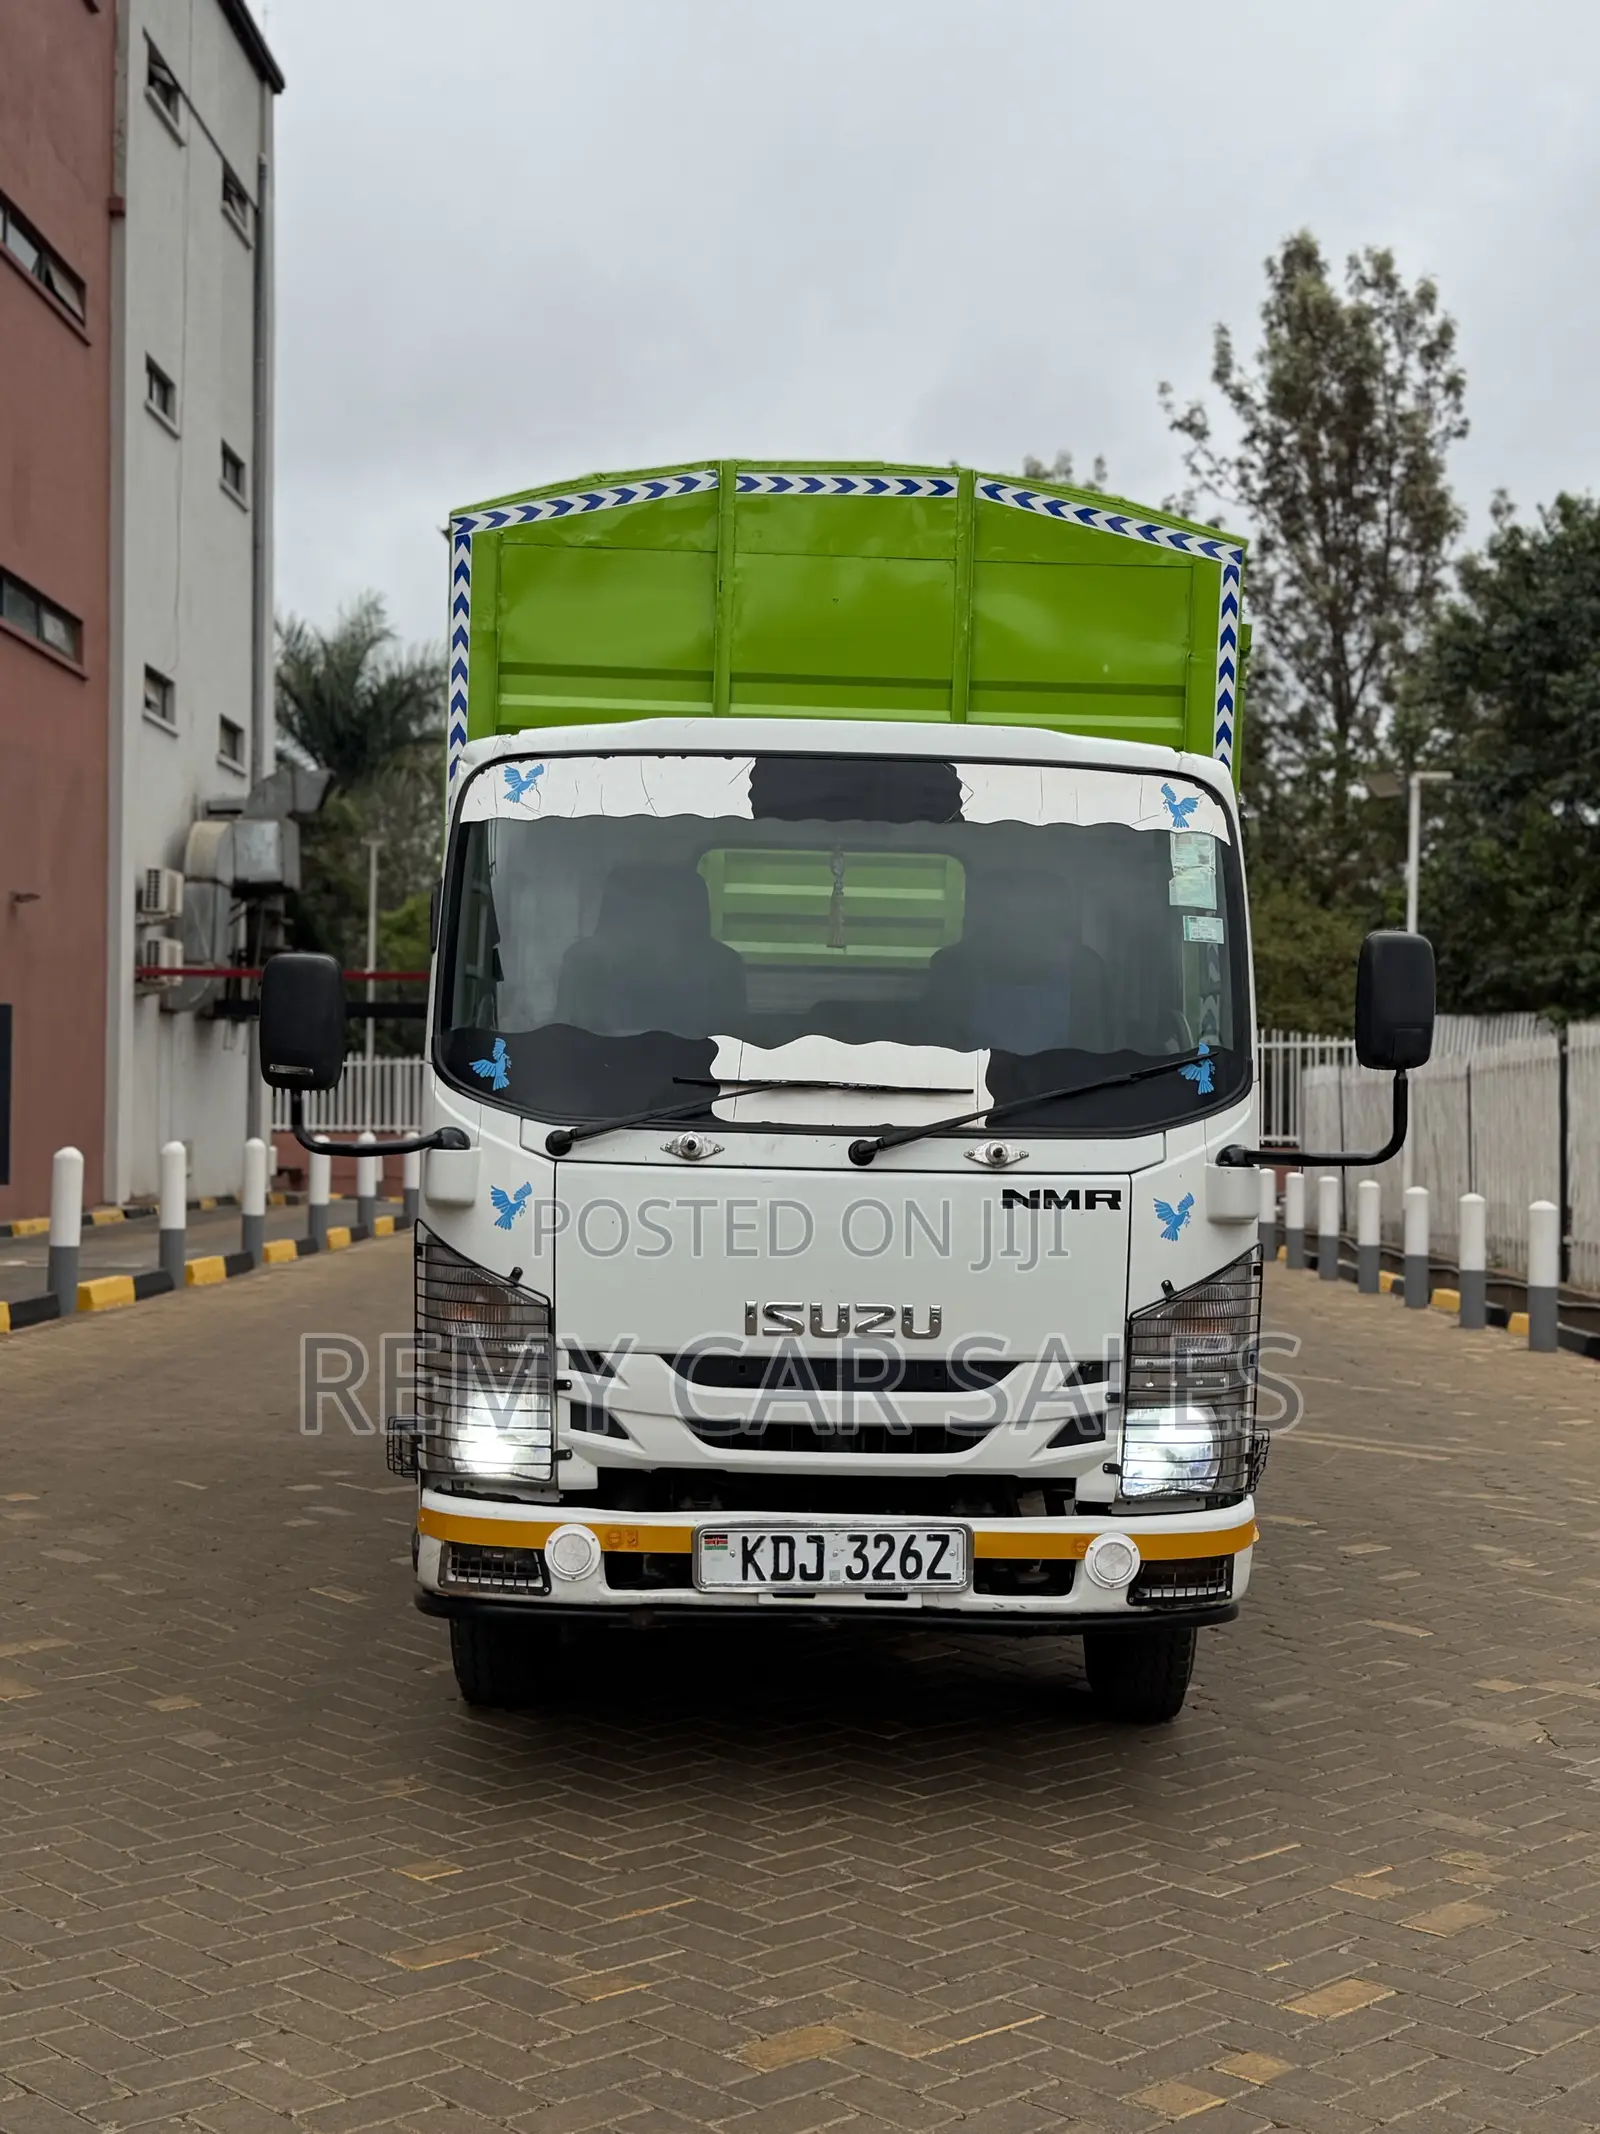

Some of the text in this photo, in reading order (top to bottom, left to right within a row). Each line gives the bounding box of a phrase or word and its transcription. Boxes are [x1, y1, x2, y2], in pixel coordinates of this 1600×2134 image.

[1002, 1188, 1122, 1211] NMR
[744, 1300, 942, 1340] ISUZU
[741, 1534, 825, 1581] KDJ
[844, 1533, 952, 1581] 326Z
